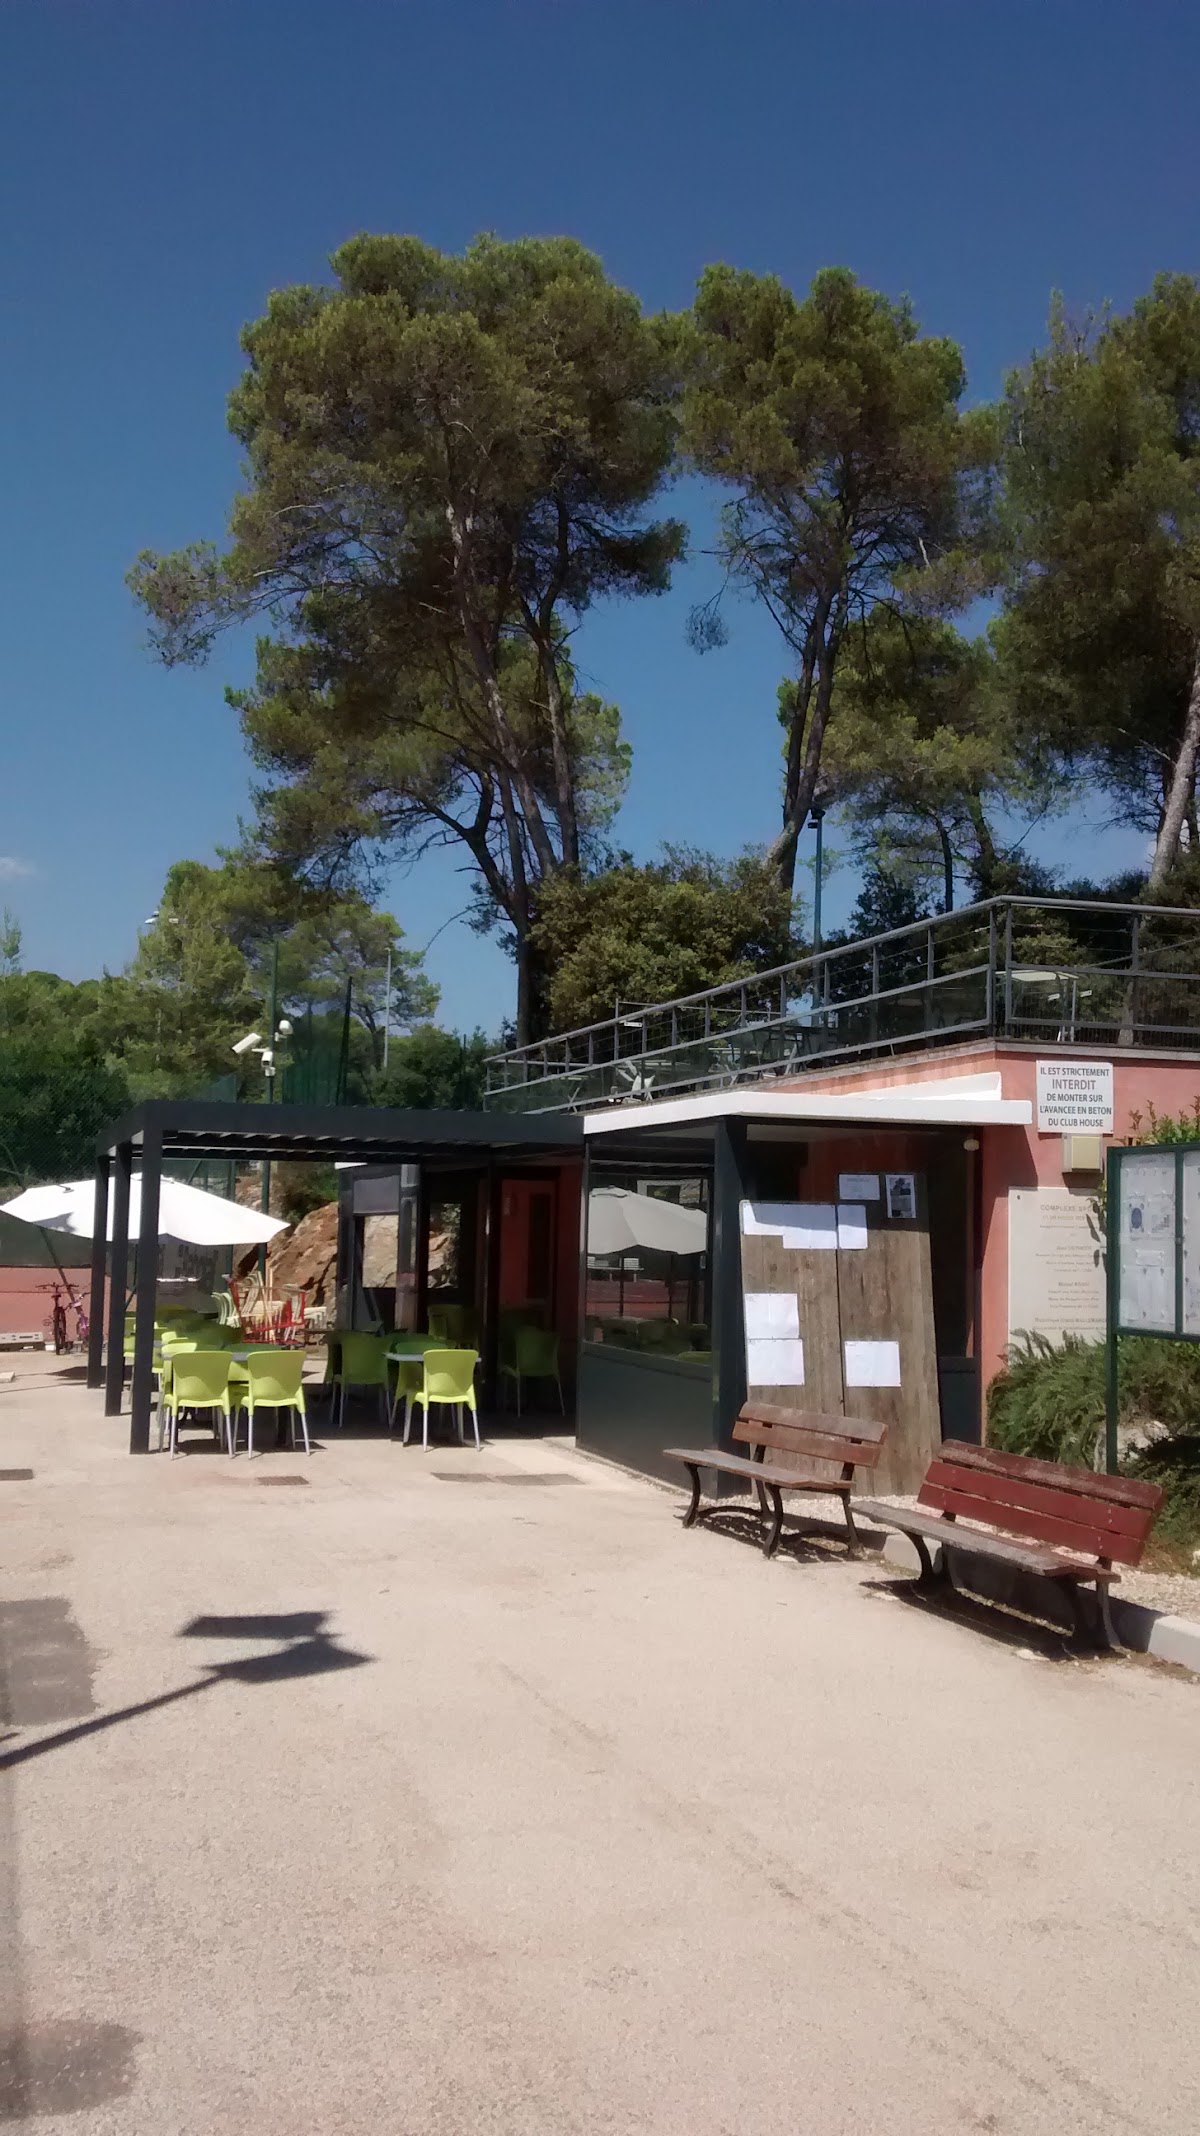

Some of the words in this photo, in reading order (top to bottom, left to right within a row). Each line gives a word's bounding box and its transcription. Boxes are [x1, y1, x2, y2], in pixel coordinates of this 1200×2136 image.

[1040, 1067, 1046, 1075] IL
[1048, 1067, 1061, 1075] EST
[1062, 1068, 1110, 1077] STRICTEMENT
[1052, 1079, 1096, 1090] INTERDIT
[1047, 1093, 1056, 1101] DE
[1057, 1094, 1088, 1102] MONTER
[1089, 1094, 1103, 1103] SUR
[1040, 1105, 1076, 1114] L'AVANCEE
[1077, 1106, 1087, 1114] EN
[1088, 1107, 1112, 1115] BETON
[1048, 1118, 1059, 1126] DU
[1060, 1118, 1078, 1126] CLUB
[1079, 1119, 1104, 1127] HOUSE
[1040, 1204, 1076, 1212] COMPLEXE
